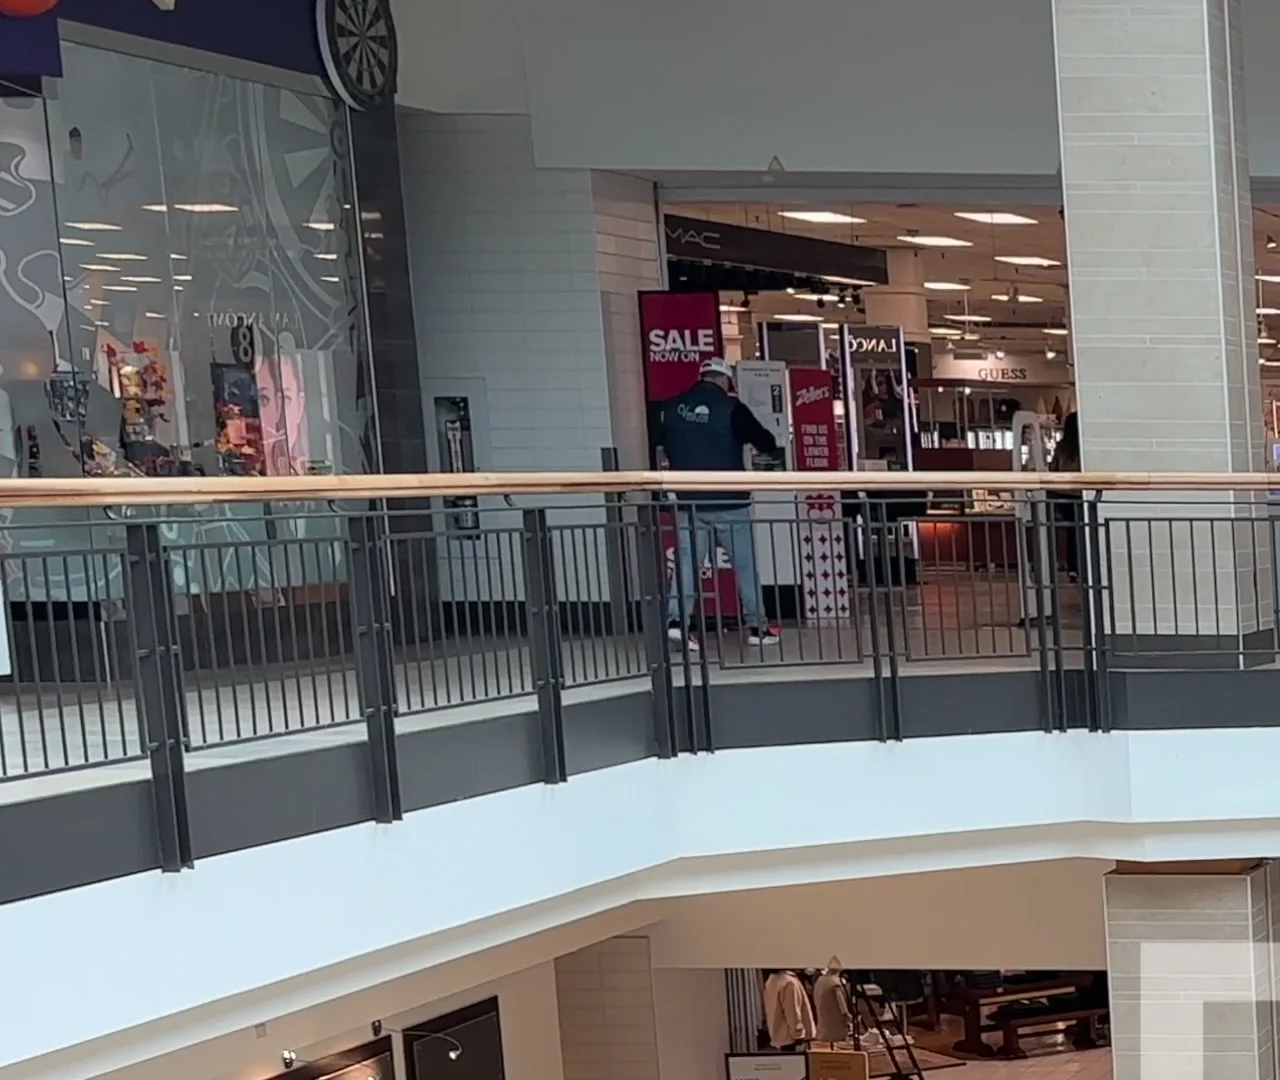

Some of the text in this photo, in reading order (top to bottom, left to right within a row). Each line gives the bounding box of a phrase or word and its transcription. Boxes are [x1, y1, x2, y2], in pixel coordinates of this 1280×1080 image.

[649, 328, 715, 352] SALE
[649, 352, 700, 363] NOW ON
[978, 367, 1028, 381] GUESS
